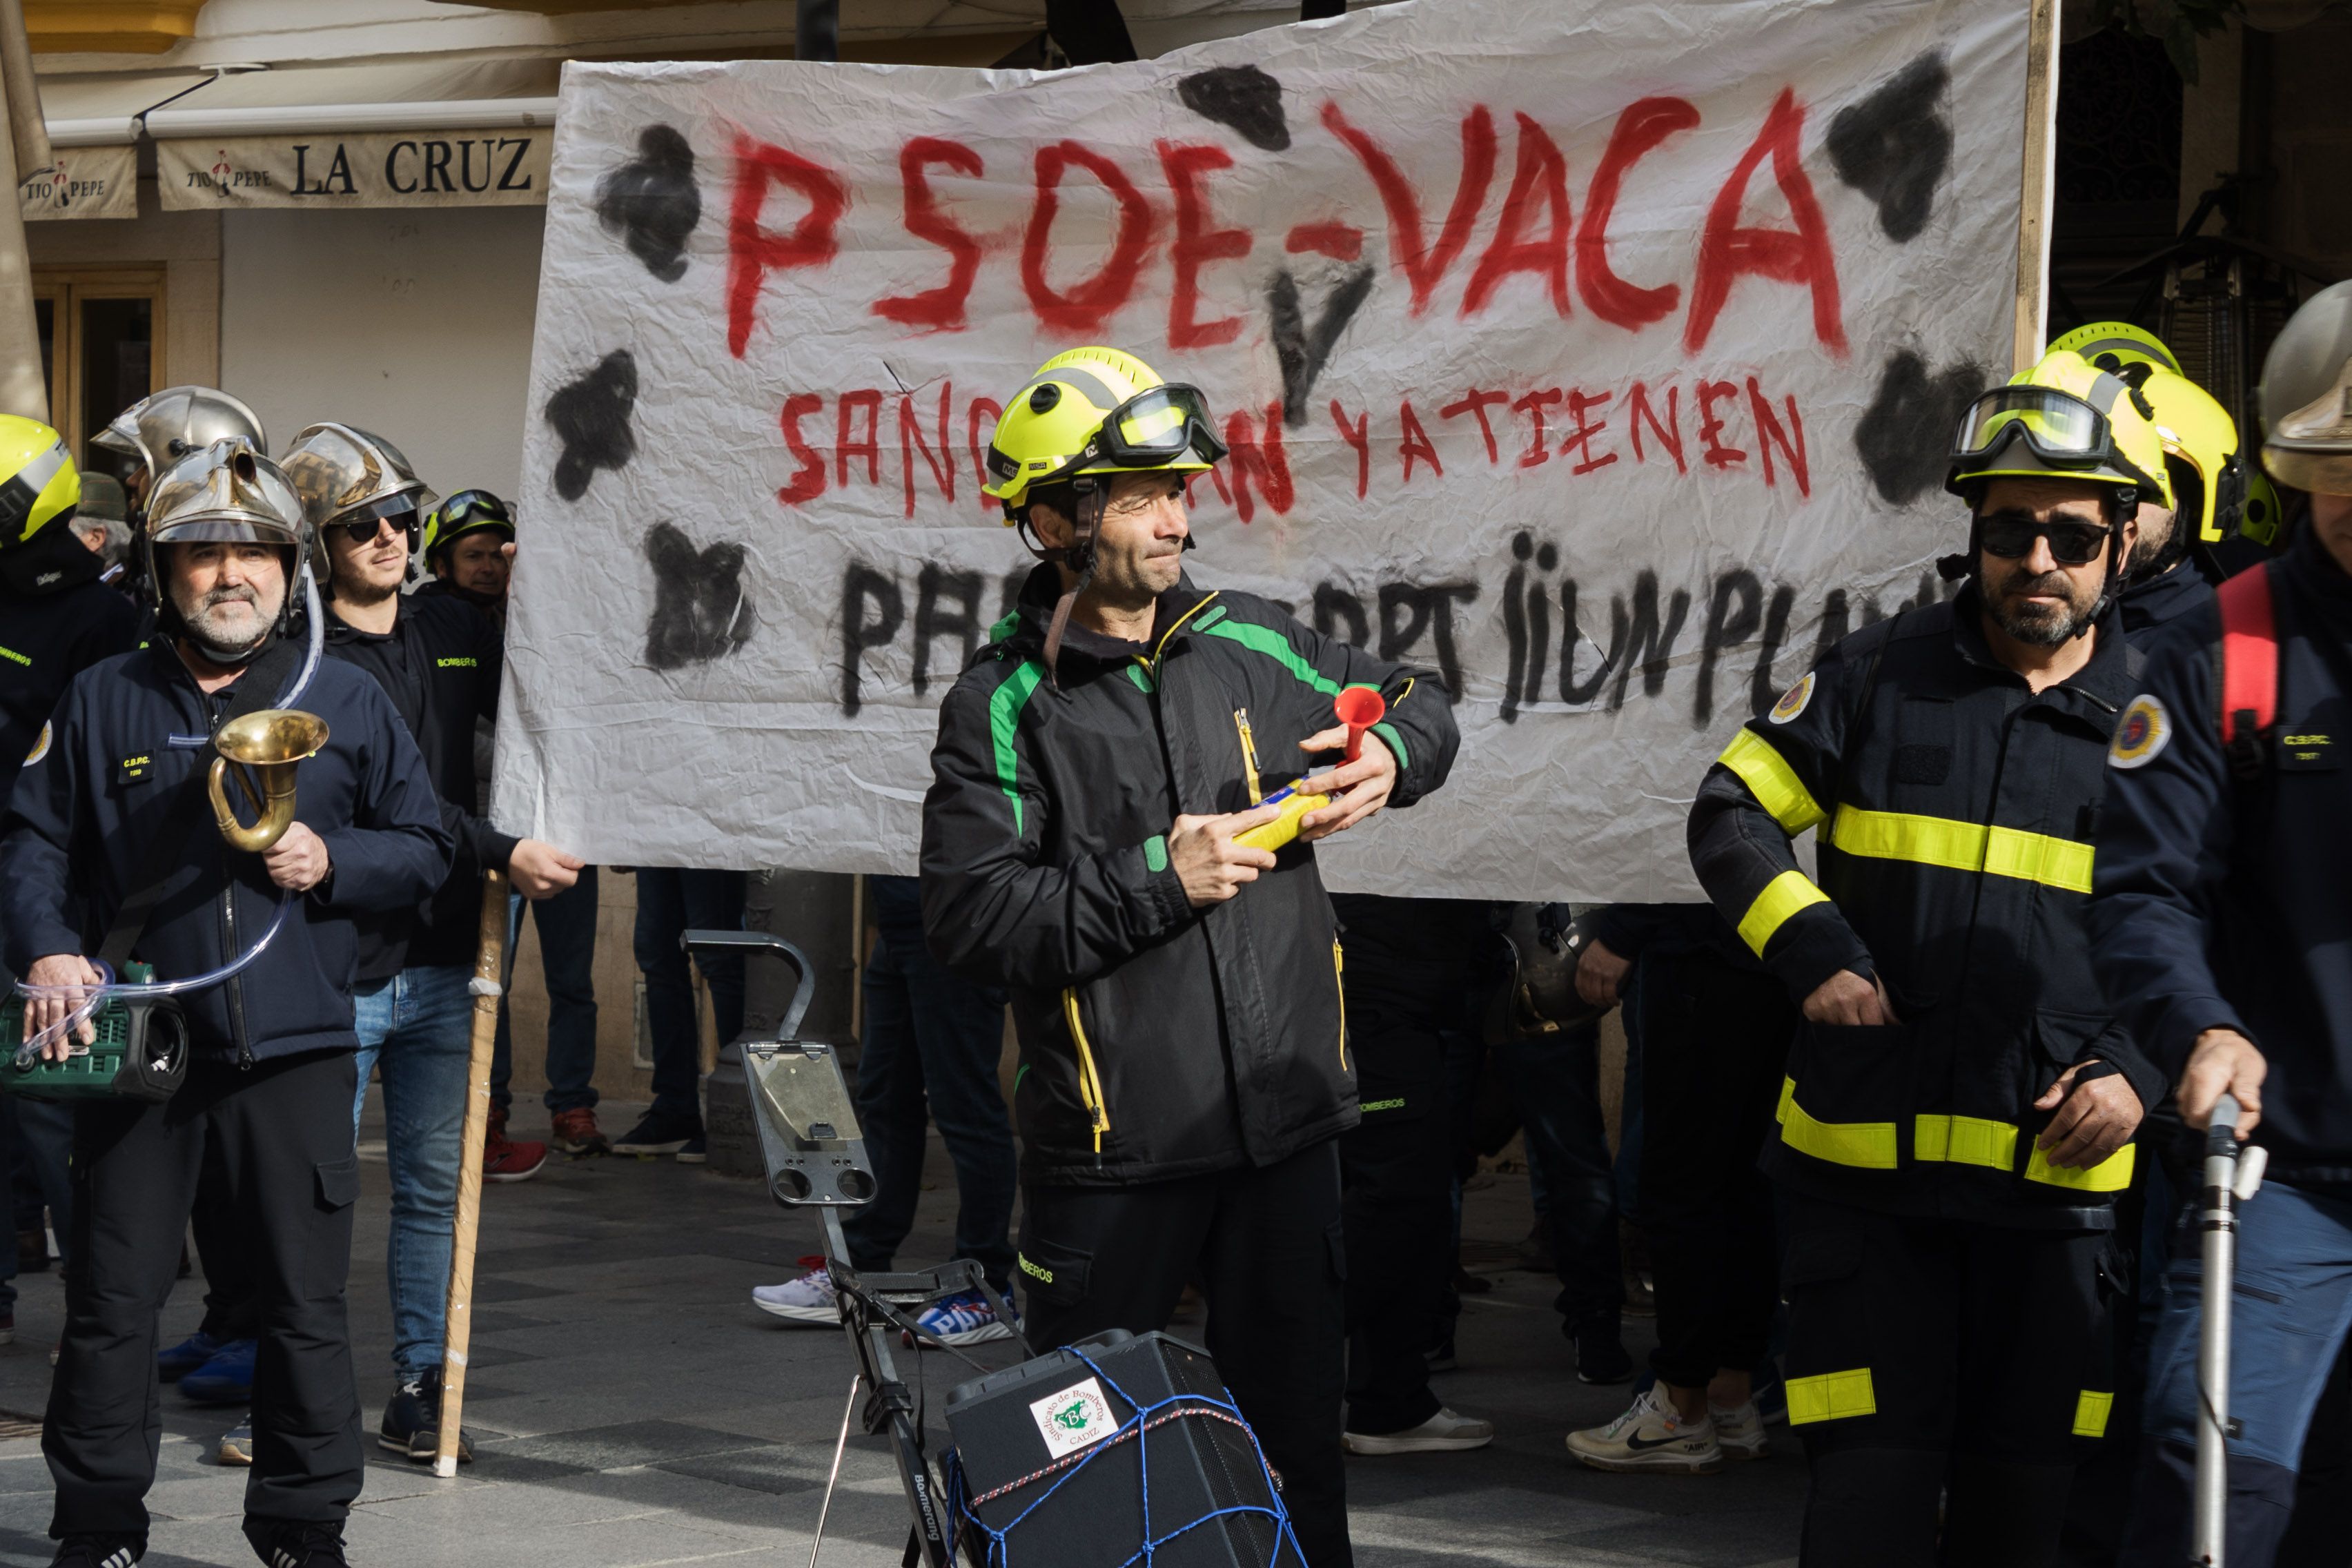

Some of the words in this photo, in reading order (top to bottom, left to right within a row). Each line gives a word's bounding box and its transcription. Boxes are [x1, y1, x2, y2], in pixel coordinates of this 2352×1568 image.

[290, 144, 358, 195] LA
[384, 137, 532, 195] CRUZ
[26, 182, 52, 199] TIO
[70, 179, 104, 198] PEPE
[187, 171, 212, 188] TIO
[233, 170, 272, 188] PEPE
[1003, 464, 1018, 477] MS
[1043, 1402, 1063, 1442] Sindicato
[1058, 1393, 1070, 1403] de
[1072, 1390, 1104, 1422] Bomberos
[1057, 1404, 1092, 1431] SBC
